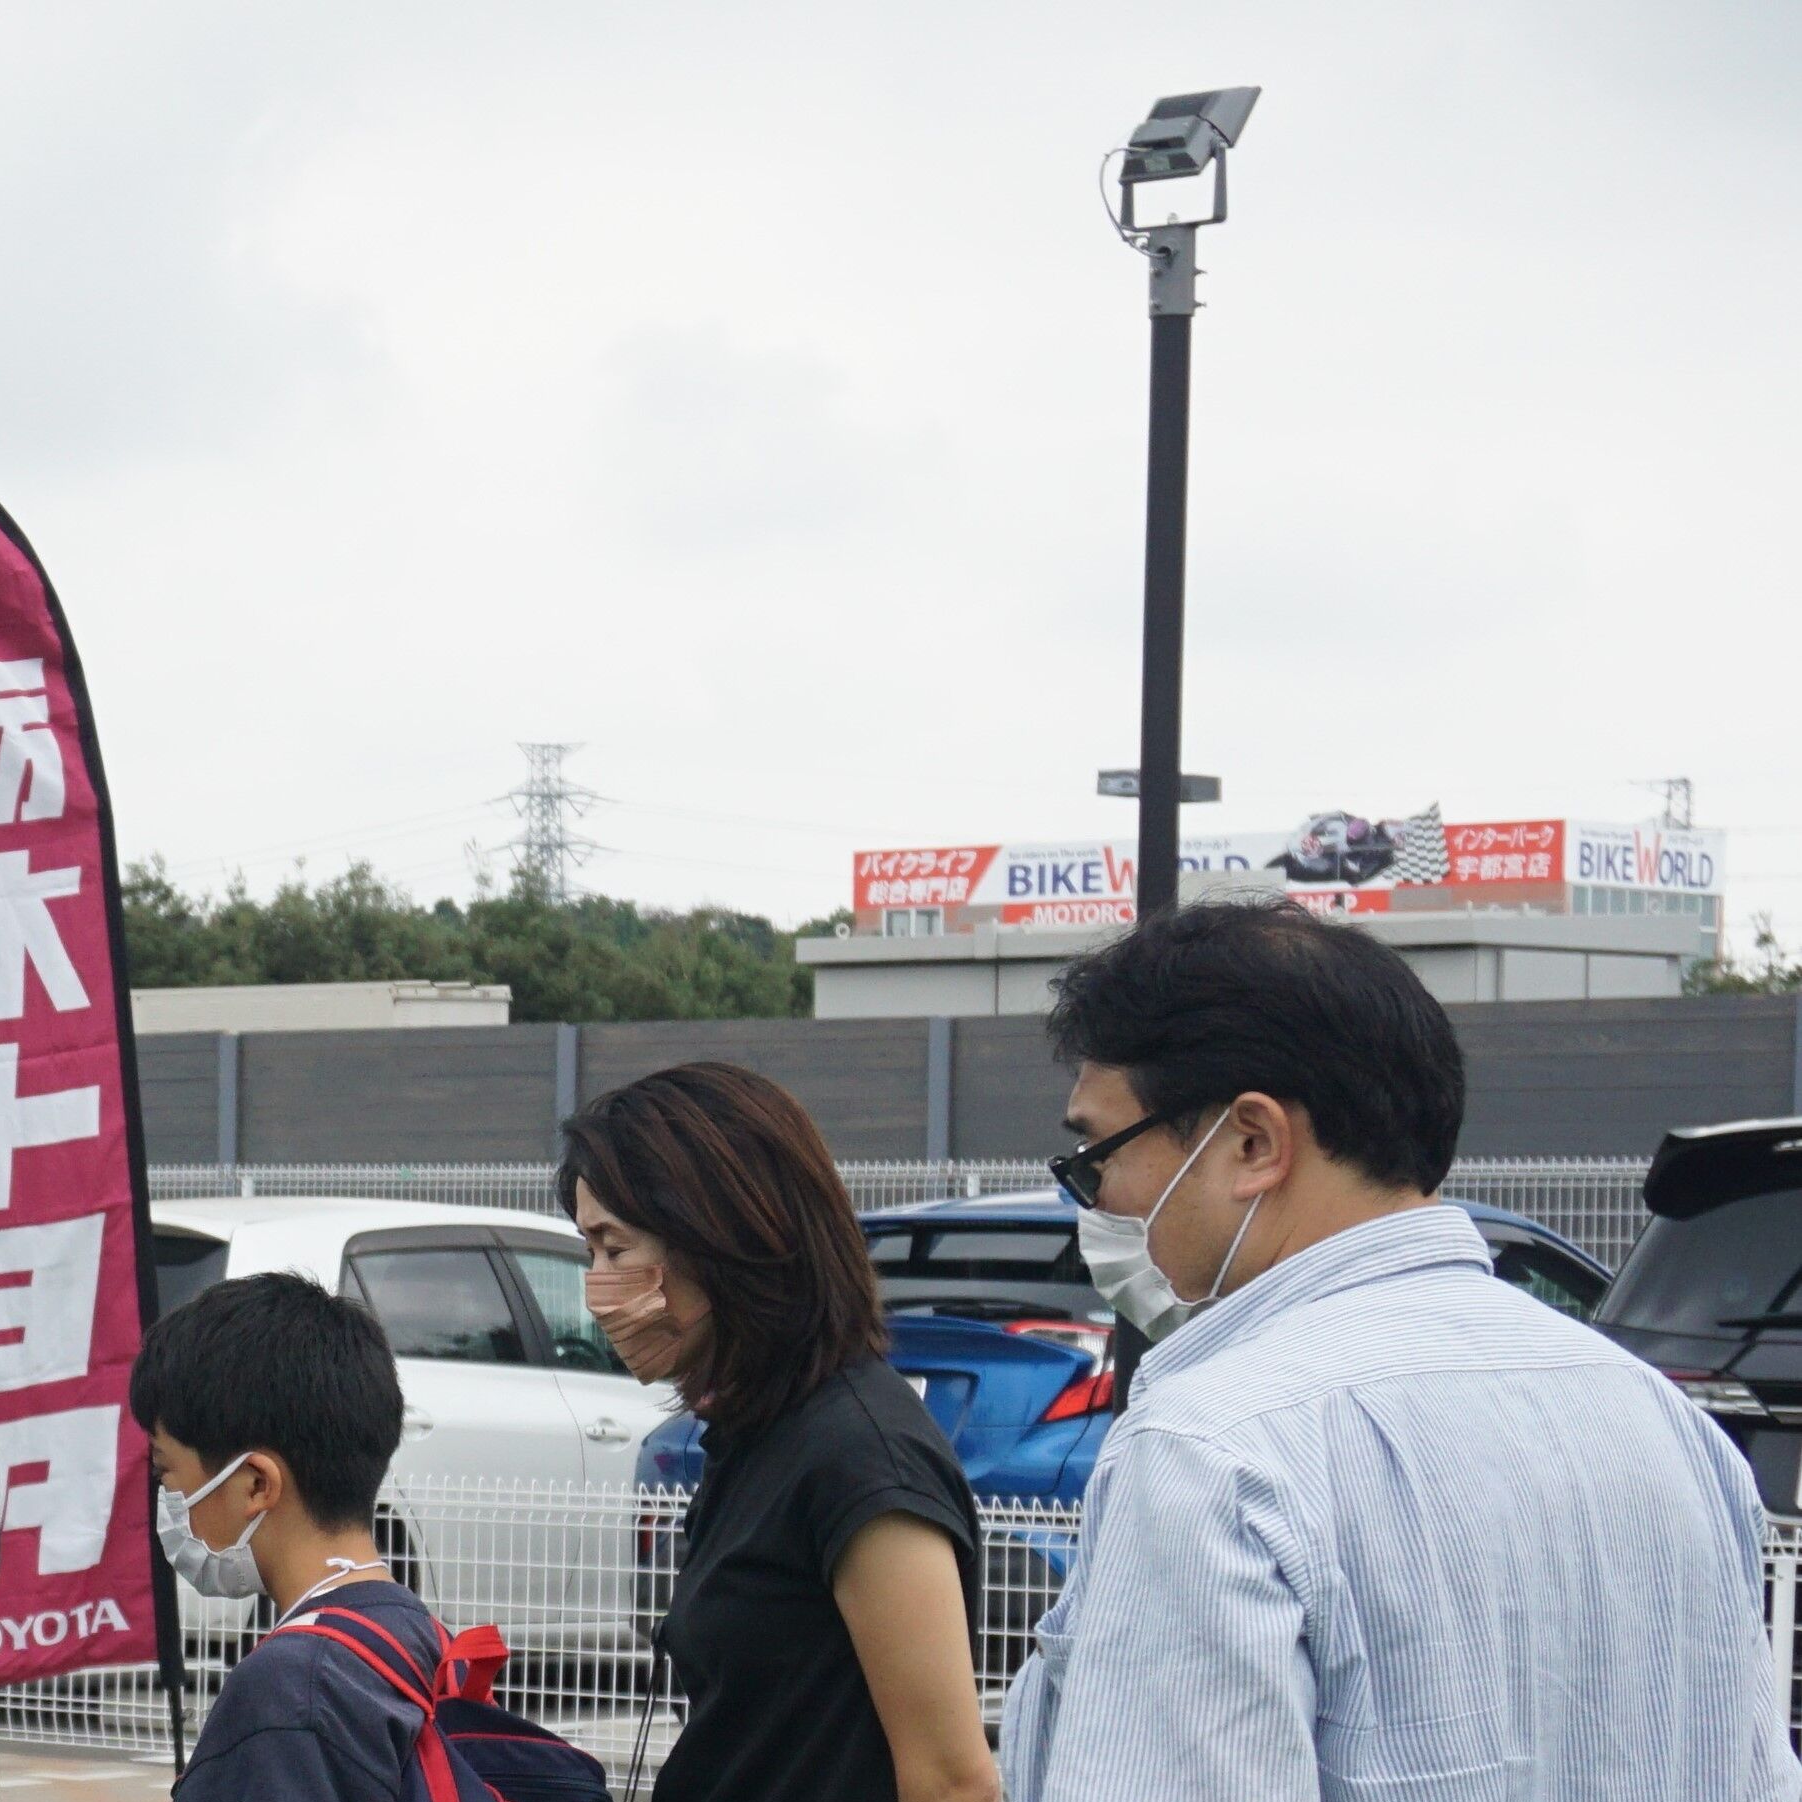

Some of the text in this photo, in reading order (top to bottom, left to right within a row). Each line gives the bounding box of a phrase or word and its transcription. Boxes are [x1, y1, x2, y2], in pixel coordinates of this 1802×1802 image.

[860, 850, 977, 877] バイクライフ
[1456, 852, 1552, 881] 宇都宮店
[1579, 830, 1713, 888] BIKEWORLD
[867, 876, 970, 904] 総合専門店
[1034, 902, 1136, 925] MOTORC
